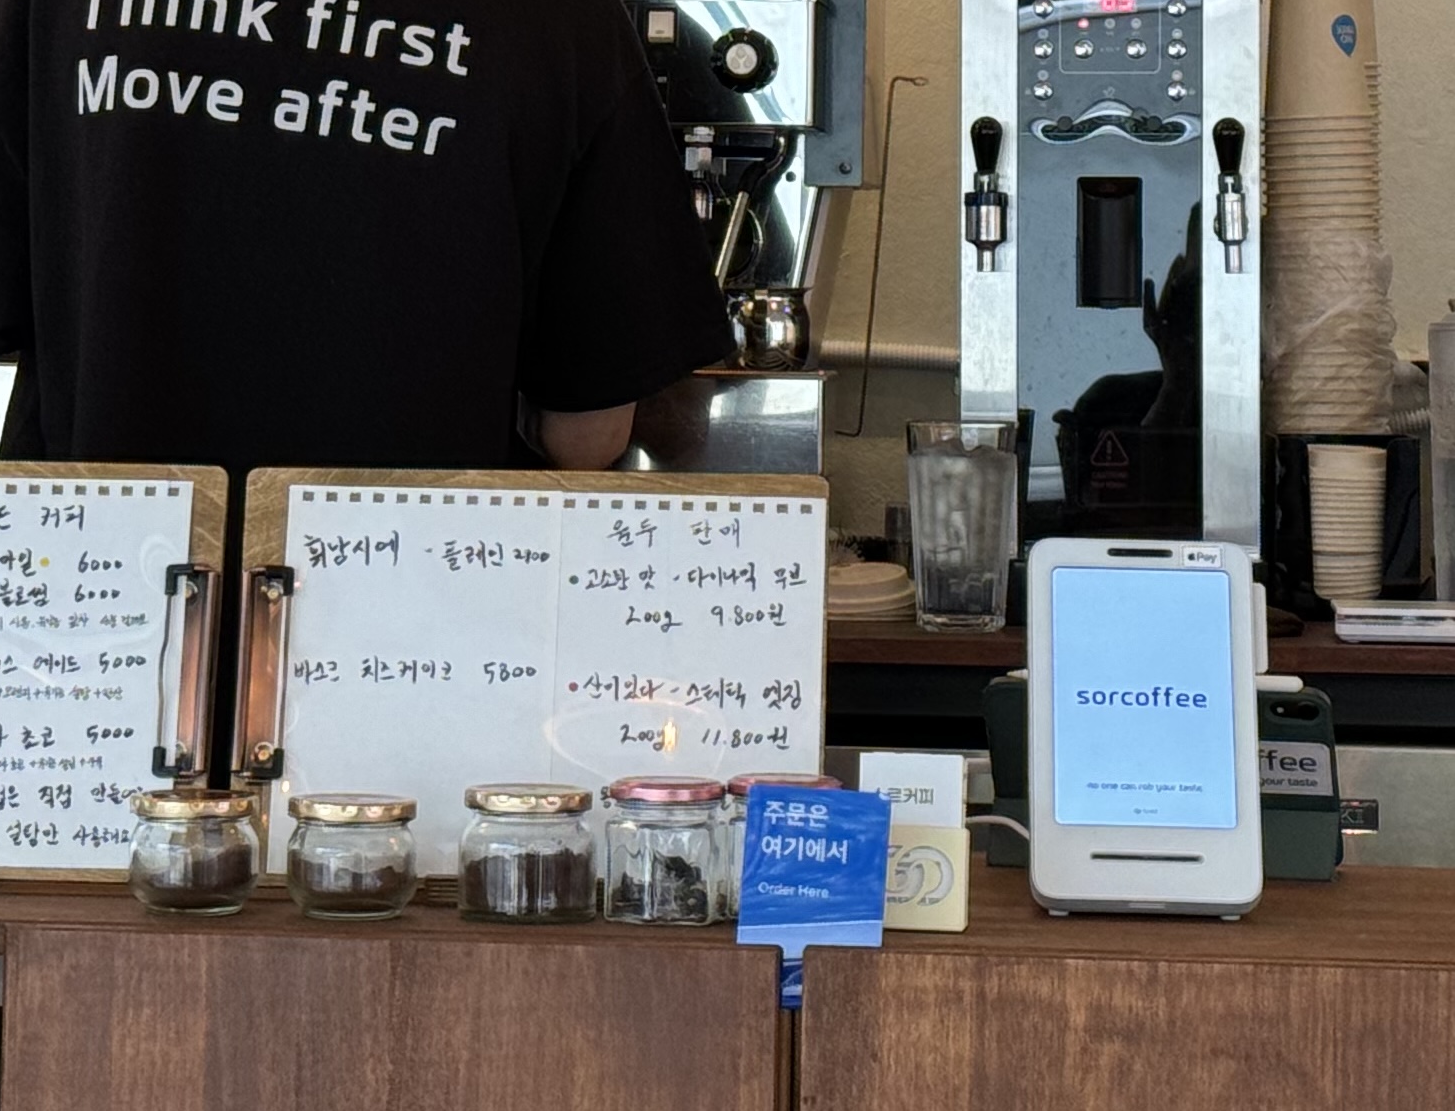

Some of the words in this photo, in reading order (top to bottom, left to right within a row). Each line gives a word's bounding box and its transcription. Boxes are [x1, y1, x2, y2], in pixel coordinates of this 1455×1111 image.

[77, 54, 244, 123] Move
[274, 79, 457, 156] after
[40, 504, 86, 532] 커피
[607, 519, 658, 549] 원두
[690, 517, 741, 549] 판매
[77, 551, 124, 573] 6000
[441, 540, 504, 572] 플레인
[74, 583, 122, 603] 6000
[624, 604, 684, 634] 200g
[32, 652, 82, 675] 에이드
[99, 651, 147, 674] 5000
[482, 661, 538, 685] 5800
[1075, 686, 1209, 710] sorcoffee
[86, 723, 135, 746] 5000
[1288, 777, 1319, 788] taste
[37, 783, 73, 810] 직접
[878, 787, 934, 805] 르커피
[763, 800, 830, 829] 주문은
[761, 835, 849, 865] 여기에서
[757, 880, 795, 897] Order
[797, 884, 830, 899] Here
